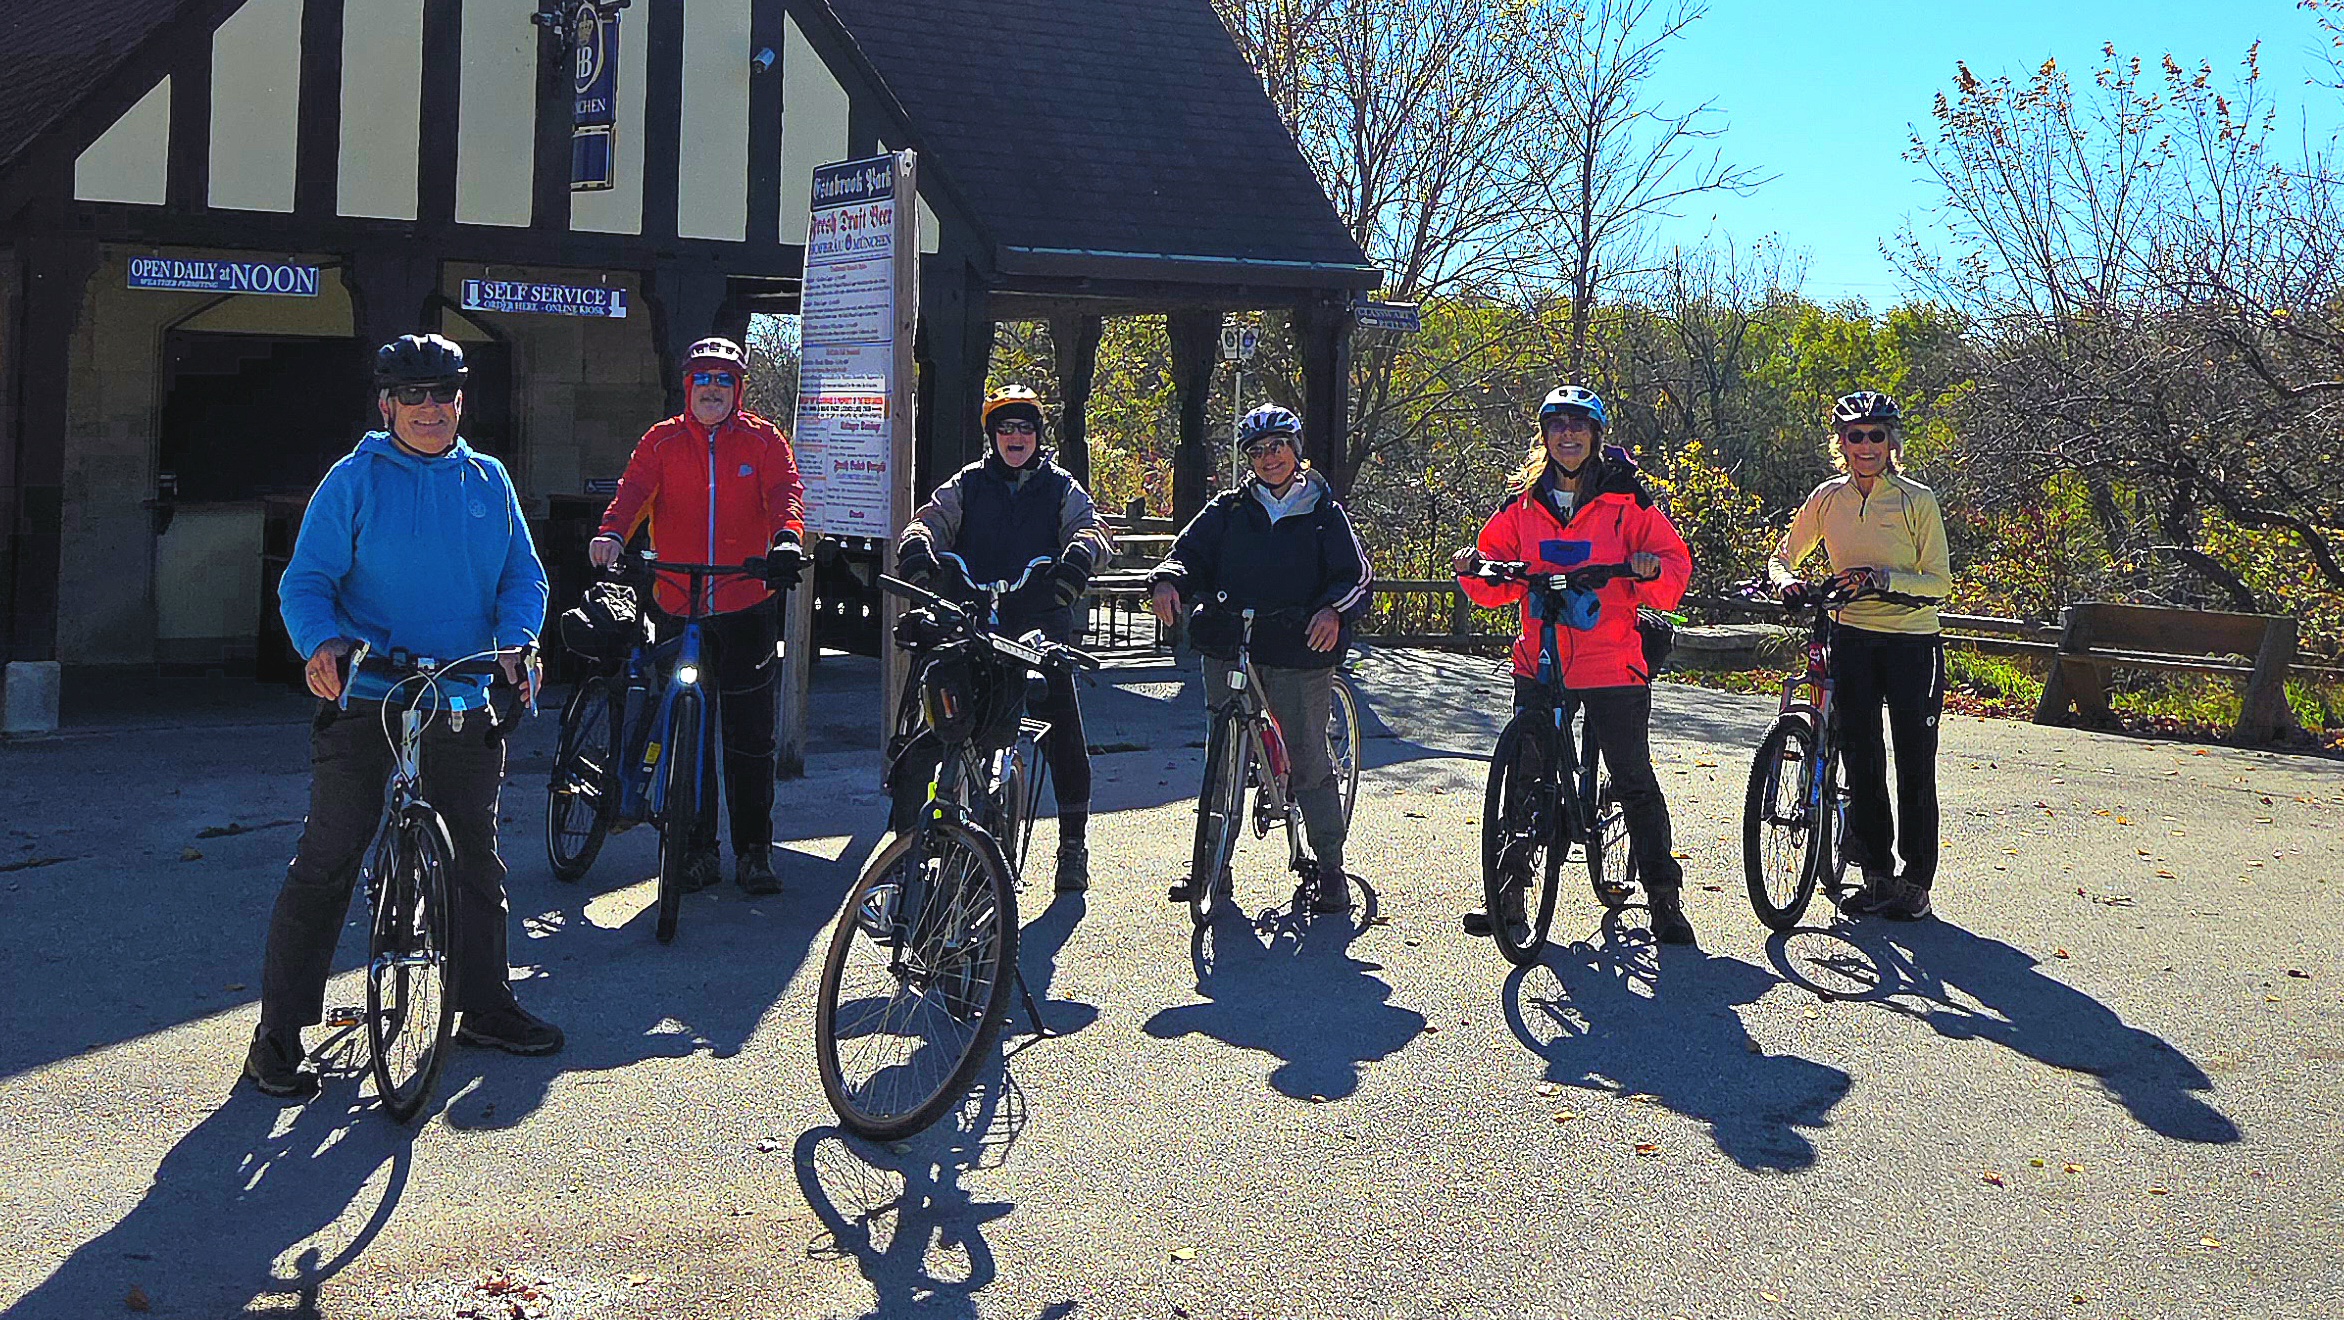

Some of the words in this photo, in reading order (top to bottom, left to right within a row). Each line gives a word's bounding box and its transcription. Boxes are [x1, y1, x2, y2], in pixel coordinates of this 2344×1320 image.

[575, 97, 606, 114] CHEN
[813, 171, 862, 199] Estabrook
[866, 165, 892, 197] Park
[839, 206, 867, 236] Draft
[870, 204, 893, 229] Beer
[131, 258, 171, 278] OPEN
[174, 260, 219, 281] DAILY
[219, 267, 230, 281] at
[229, 263, 317, 293] NOON
[484, 283, 529, 300] SELF
[530, 285, 607, 306] SERVICE
[545, 303, 578, 314] ONLINE
[579, 305, 605, 316] KIOSK
